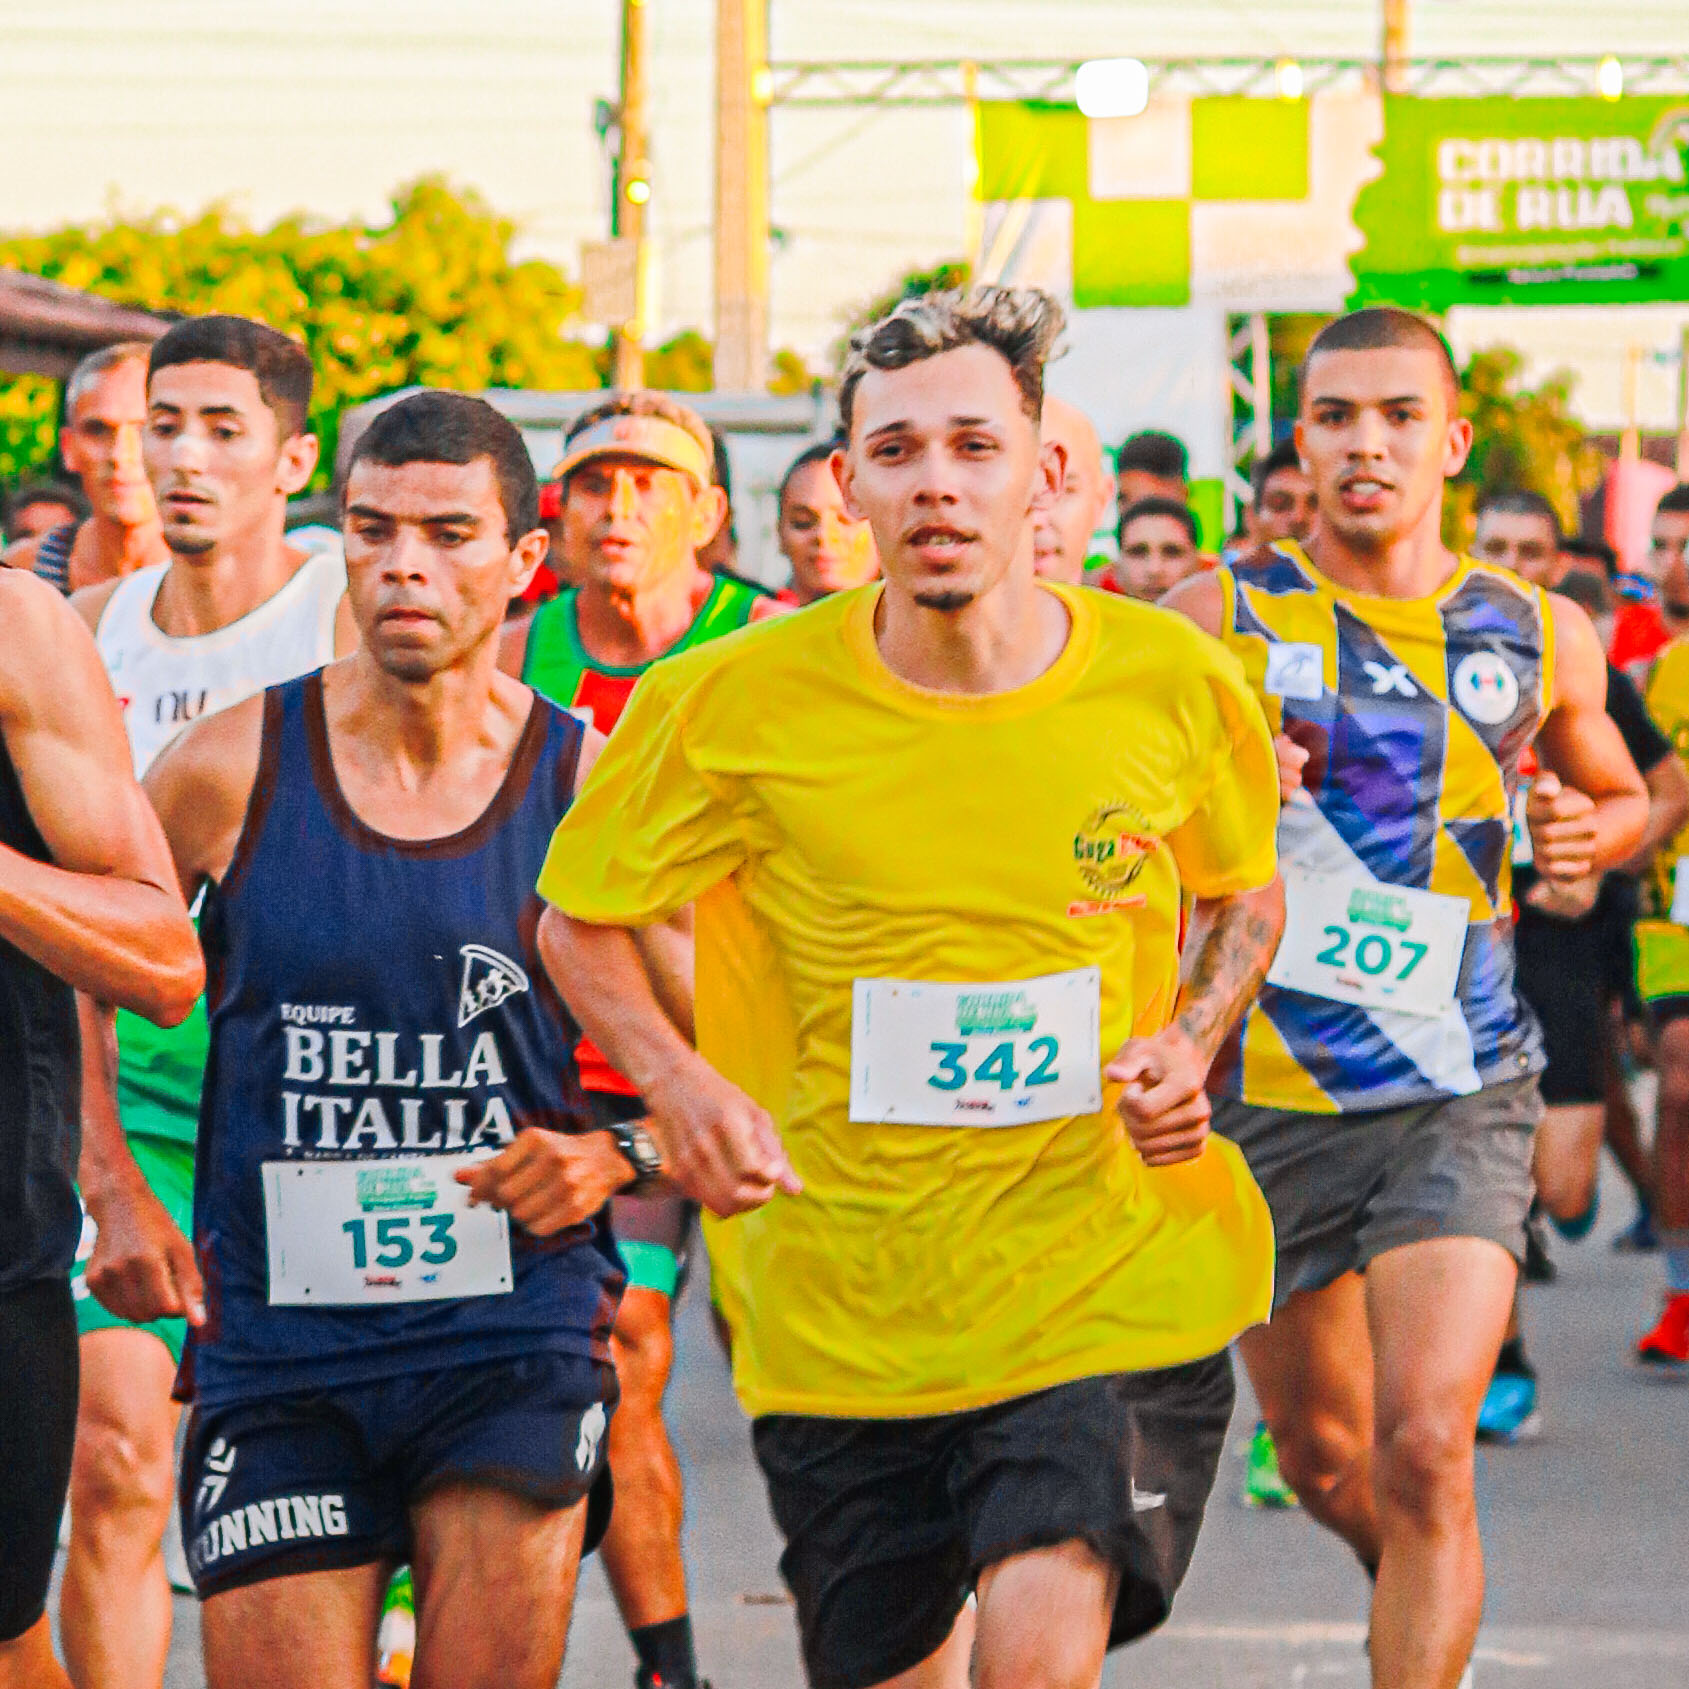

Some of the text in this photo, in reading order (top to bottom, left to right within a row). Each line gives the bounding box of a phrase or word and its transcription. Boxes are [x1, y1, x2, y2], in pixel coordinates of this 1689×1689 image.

[1438, 137, 1685, 183] CORRIDA
[1439, 188, 1504, 232] DE
[1516, 187, 1635, 231] RUA
[1316, 925, 1429, 981] 207
[280, 1002, 357, 1025] EQUIPE
[282, 1026, 509, 1089] BELLA
[927, 1035, 1060, 1091] 342
[281, 1091, 516, 1150] ITALIA
[341, 1213, 458, 1269] 153
